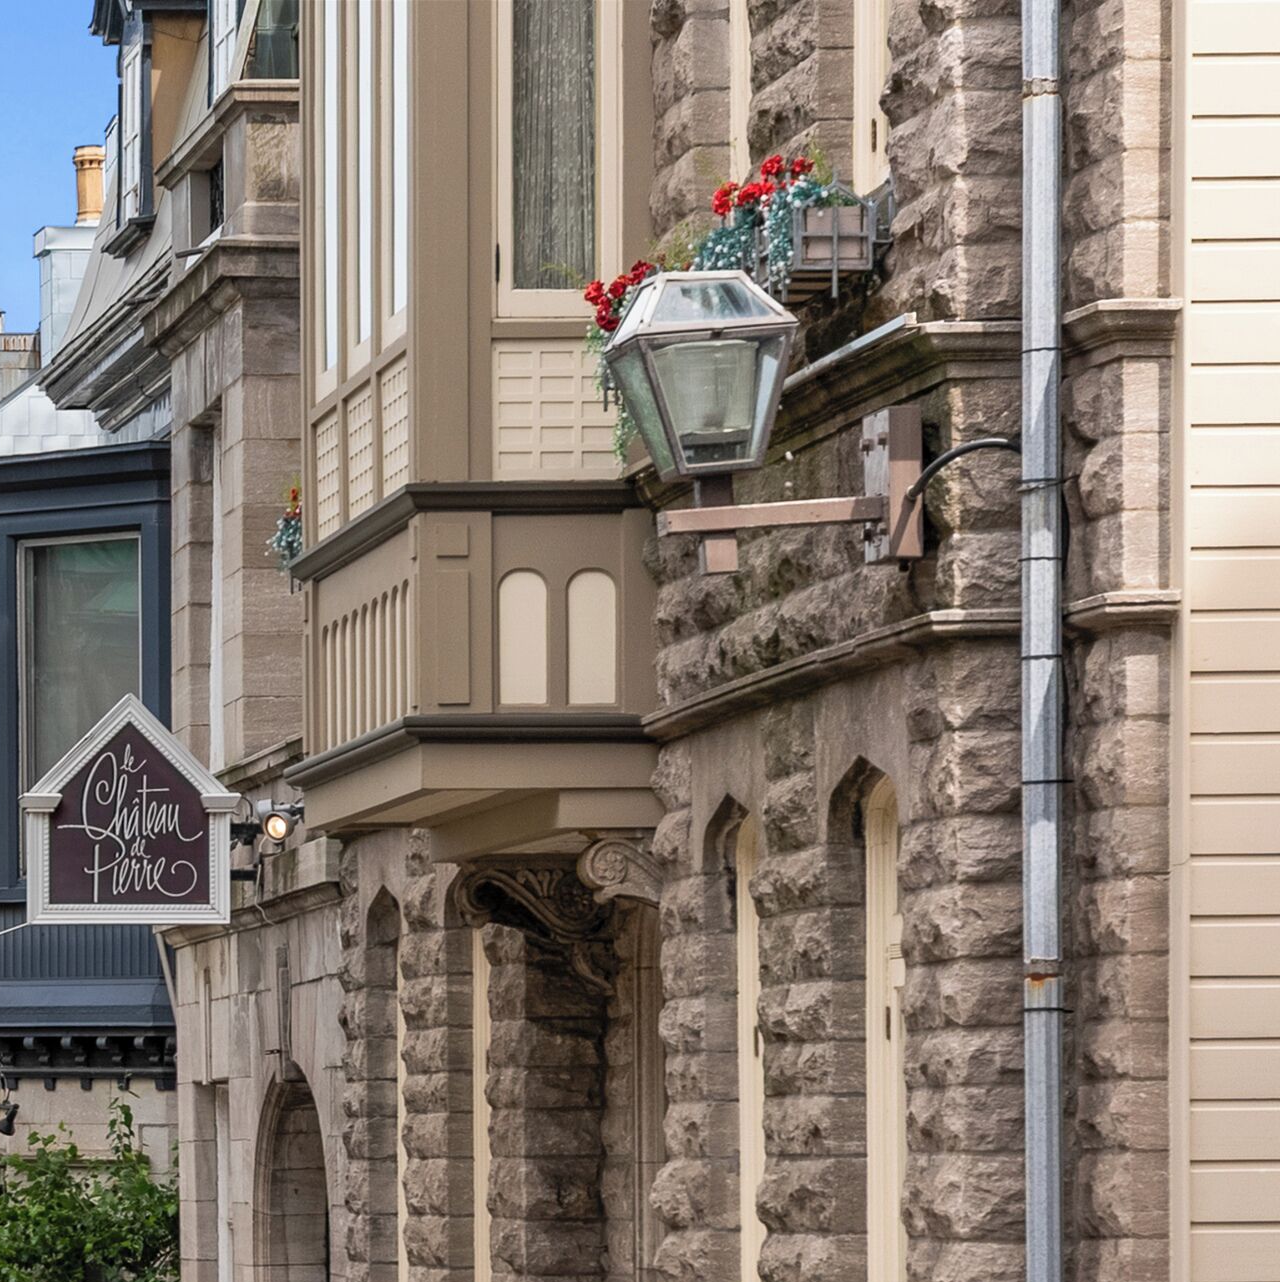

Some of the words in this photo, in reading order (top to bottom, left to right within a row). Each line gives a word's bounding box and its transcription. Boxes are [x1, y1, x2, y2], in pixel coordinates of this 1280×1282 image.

[120, 744, 147, 773] le
[81, 751, 204, 842] Château
[129, 836, 151, 859] de
[83, 843, 198, 903] Pierre
